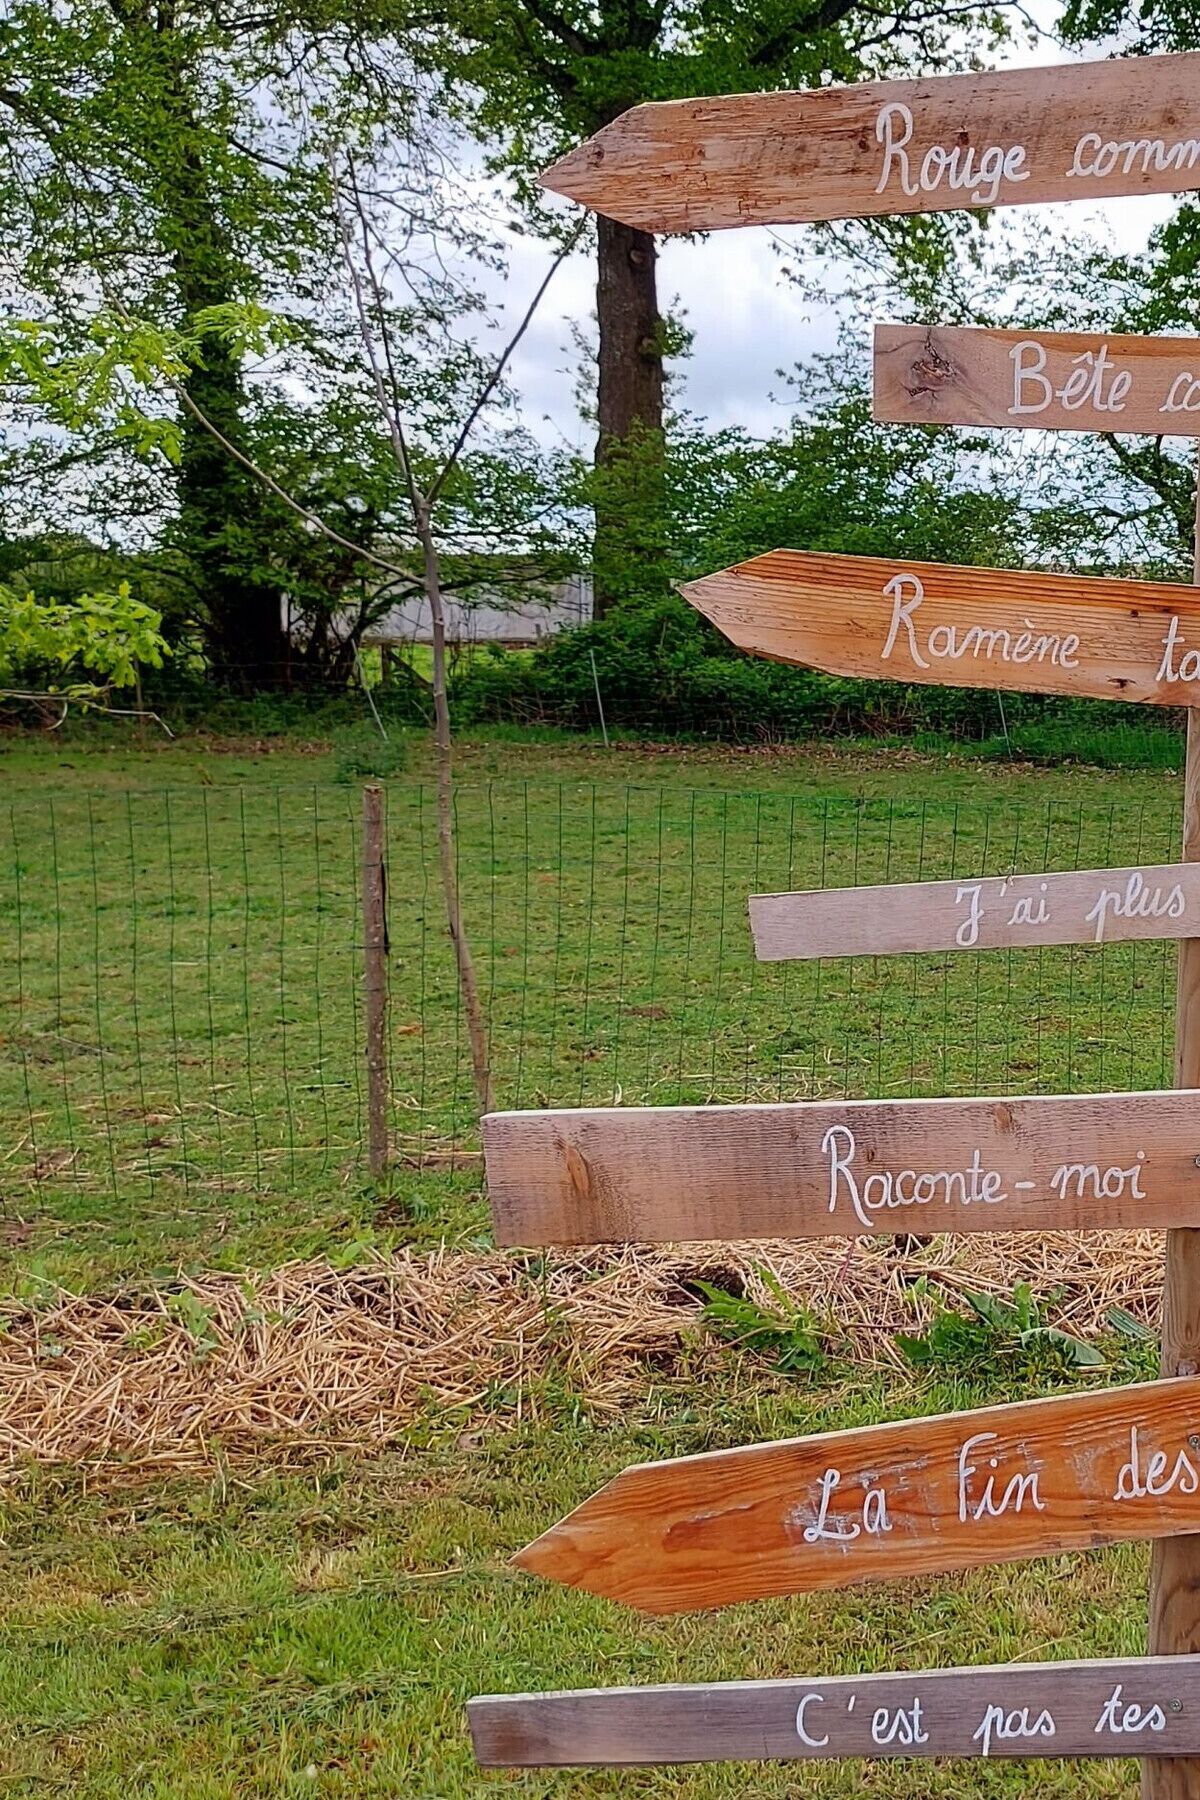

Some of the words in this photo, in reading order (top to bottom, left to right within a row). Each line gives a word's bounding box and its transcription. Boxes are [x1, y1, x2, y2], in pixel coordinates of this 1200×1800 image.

[875, 102, 1030, 203] Rouge
[1007, 340, 1132, 414] Bête
[881, 572, 1080, 669] Ramène
[954, 883, 1051, 947] J'ai
[1086, 872, 1186, 943] plus
[1112, 1426, 1200, 1501] des
[796, 1693, 930, 1746] C'est
[973, 1703, 1056, 1756] pas
[1094, 1684, 1166, 1732] tes
